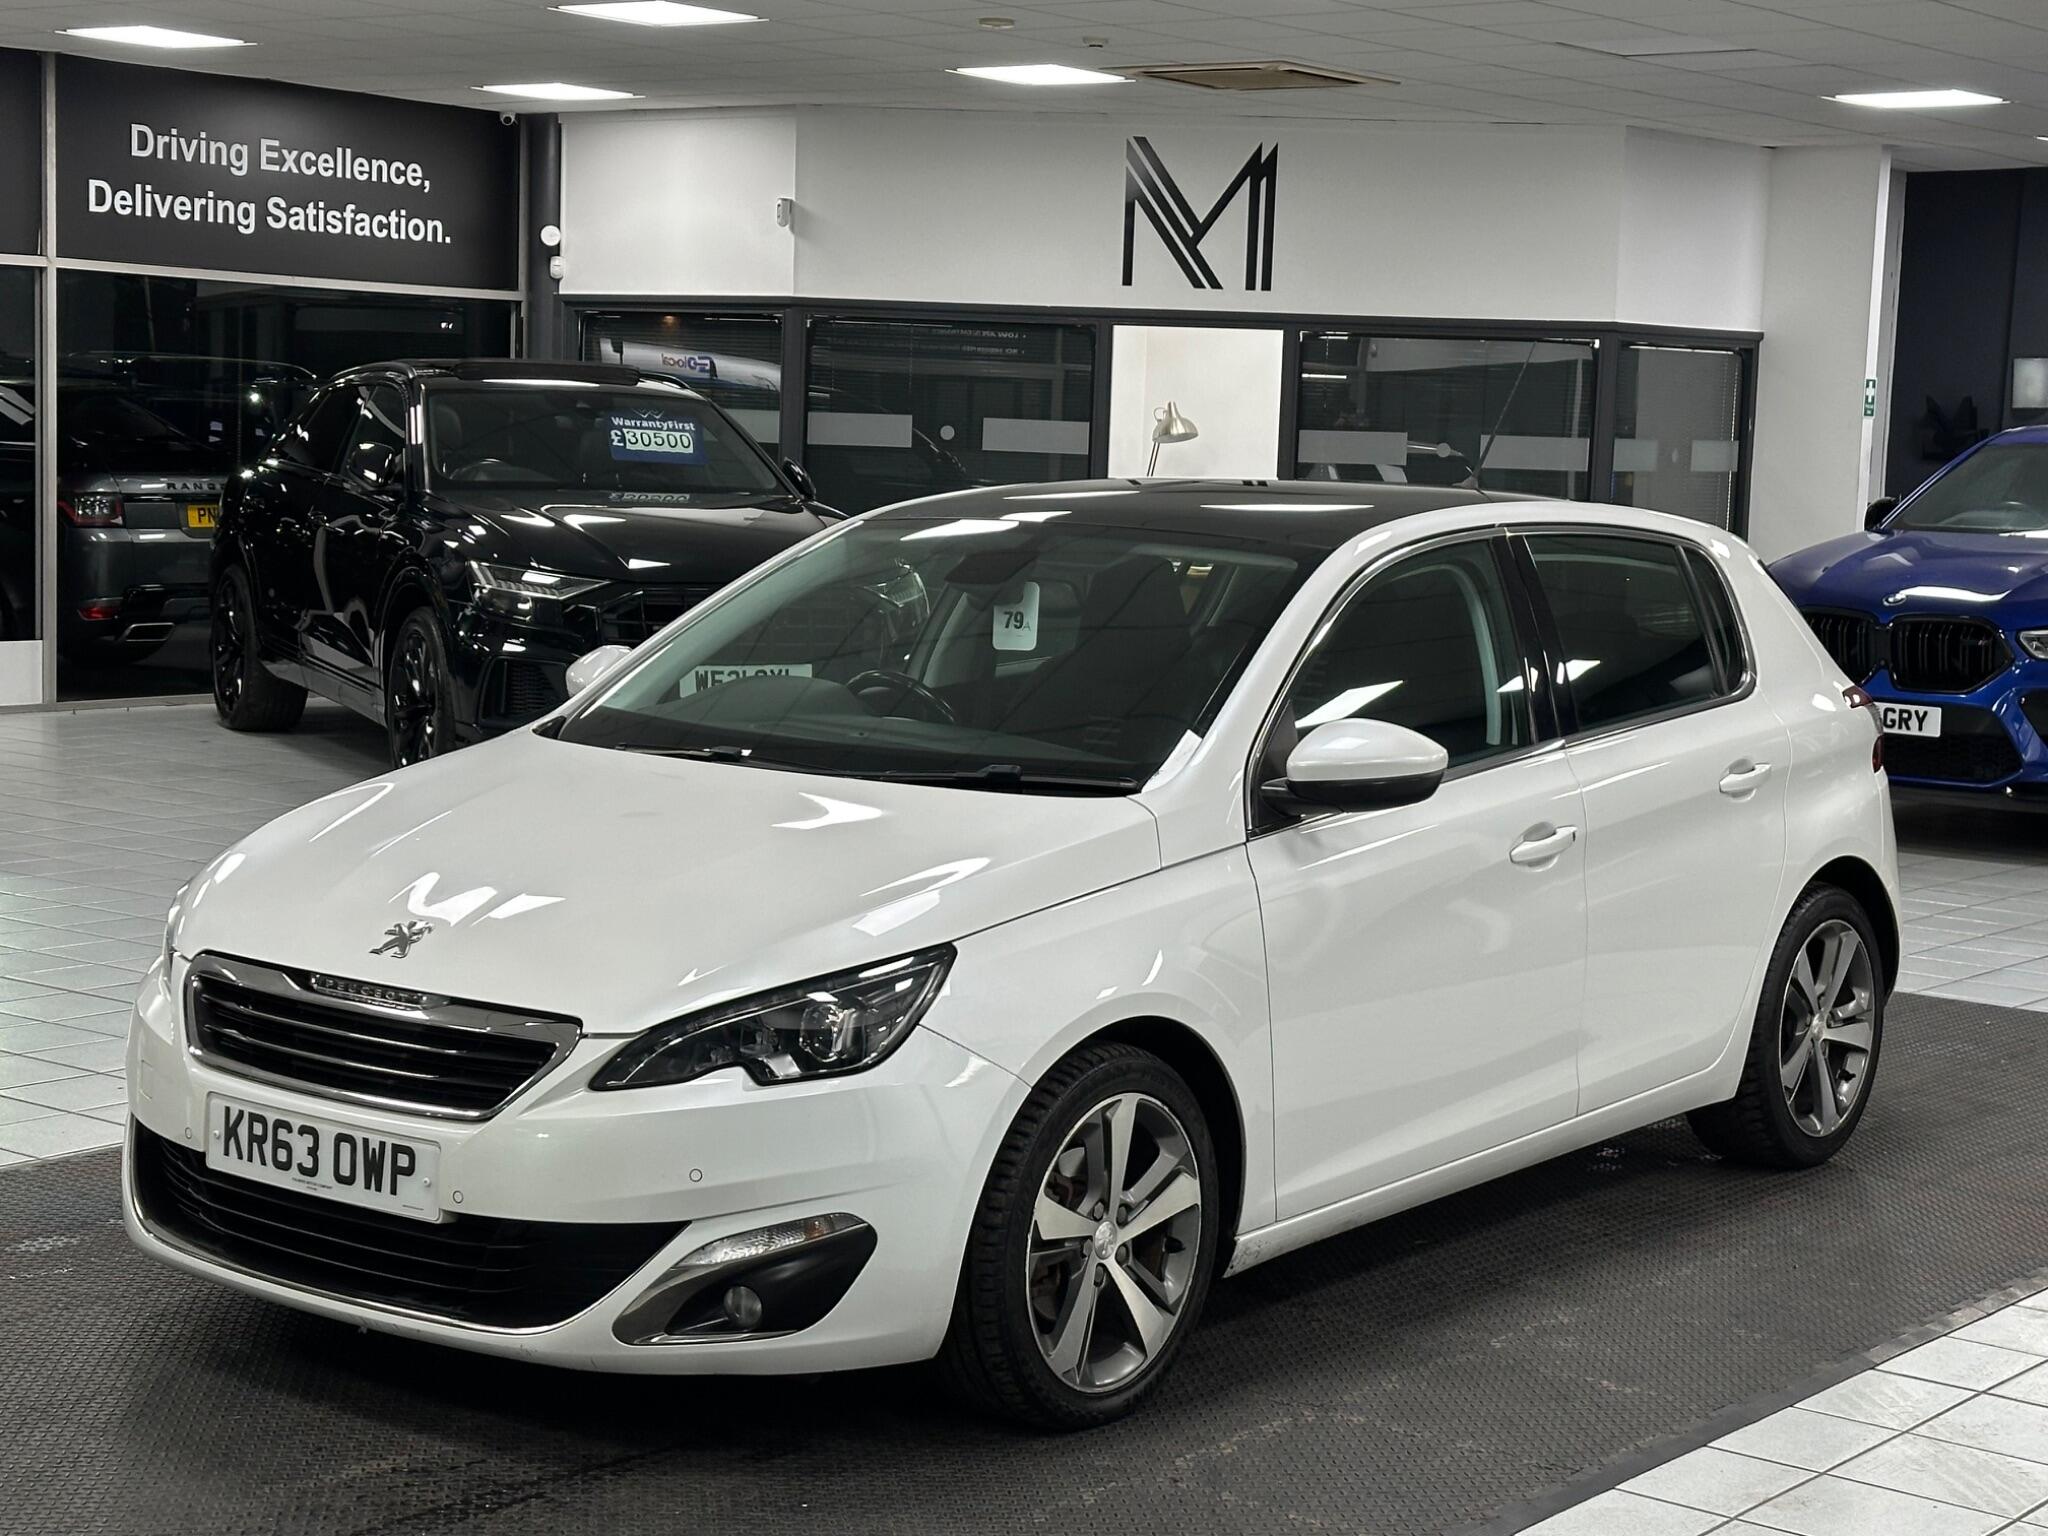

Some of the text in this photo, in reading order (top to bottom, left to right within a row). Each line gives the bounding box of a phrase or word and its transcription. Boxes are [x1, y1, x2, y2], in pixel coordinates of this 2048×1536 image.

[131, 123, 430, 193] Driving Excellence,
[88, 179, 451, 243] Delivering Satisfaction.
[611, 417, 696, 431] WarrantyFirst
[1883, 707, 1928, 732] GRY
[223, 1106, 416, 1196] KR63 OWP
